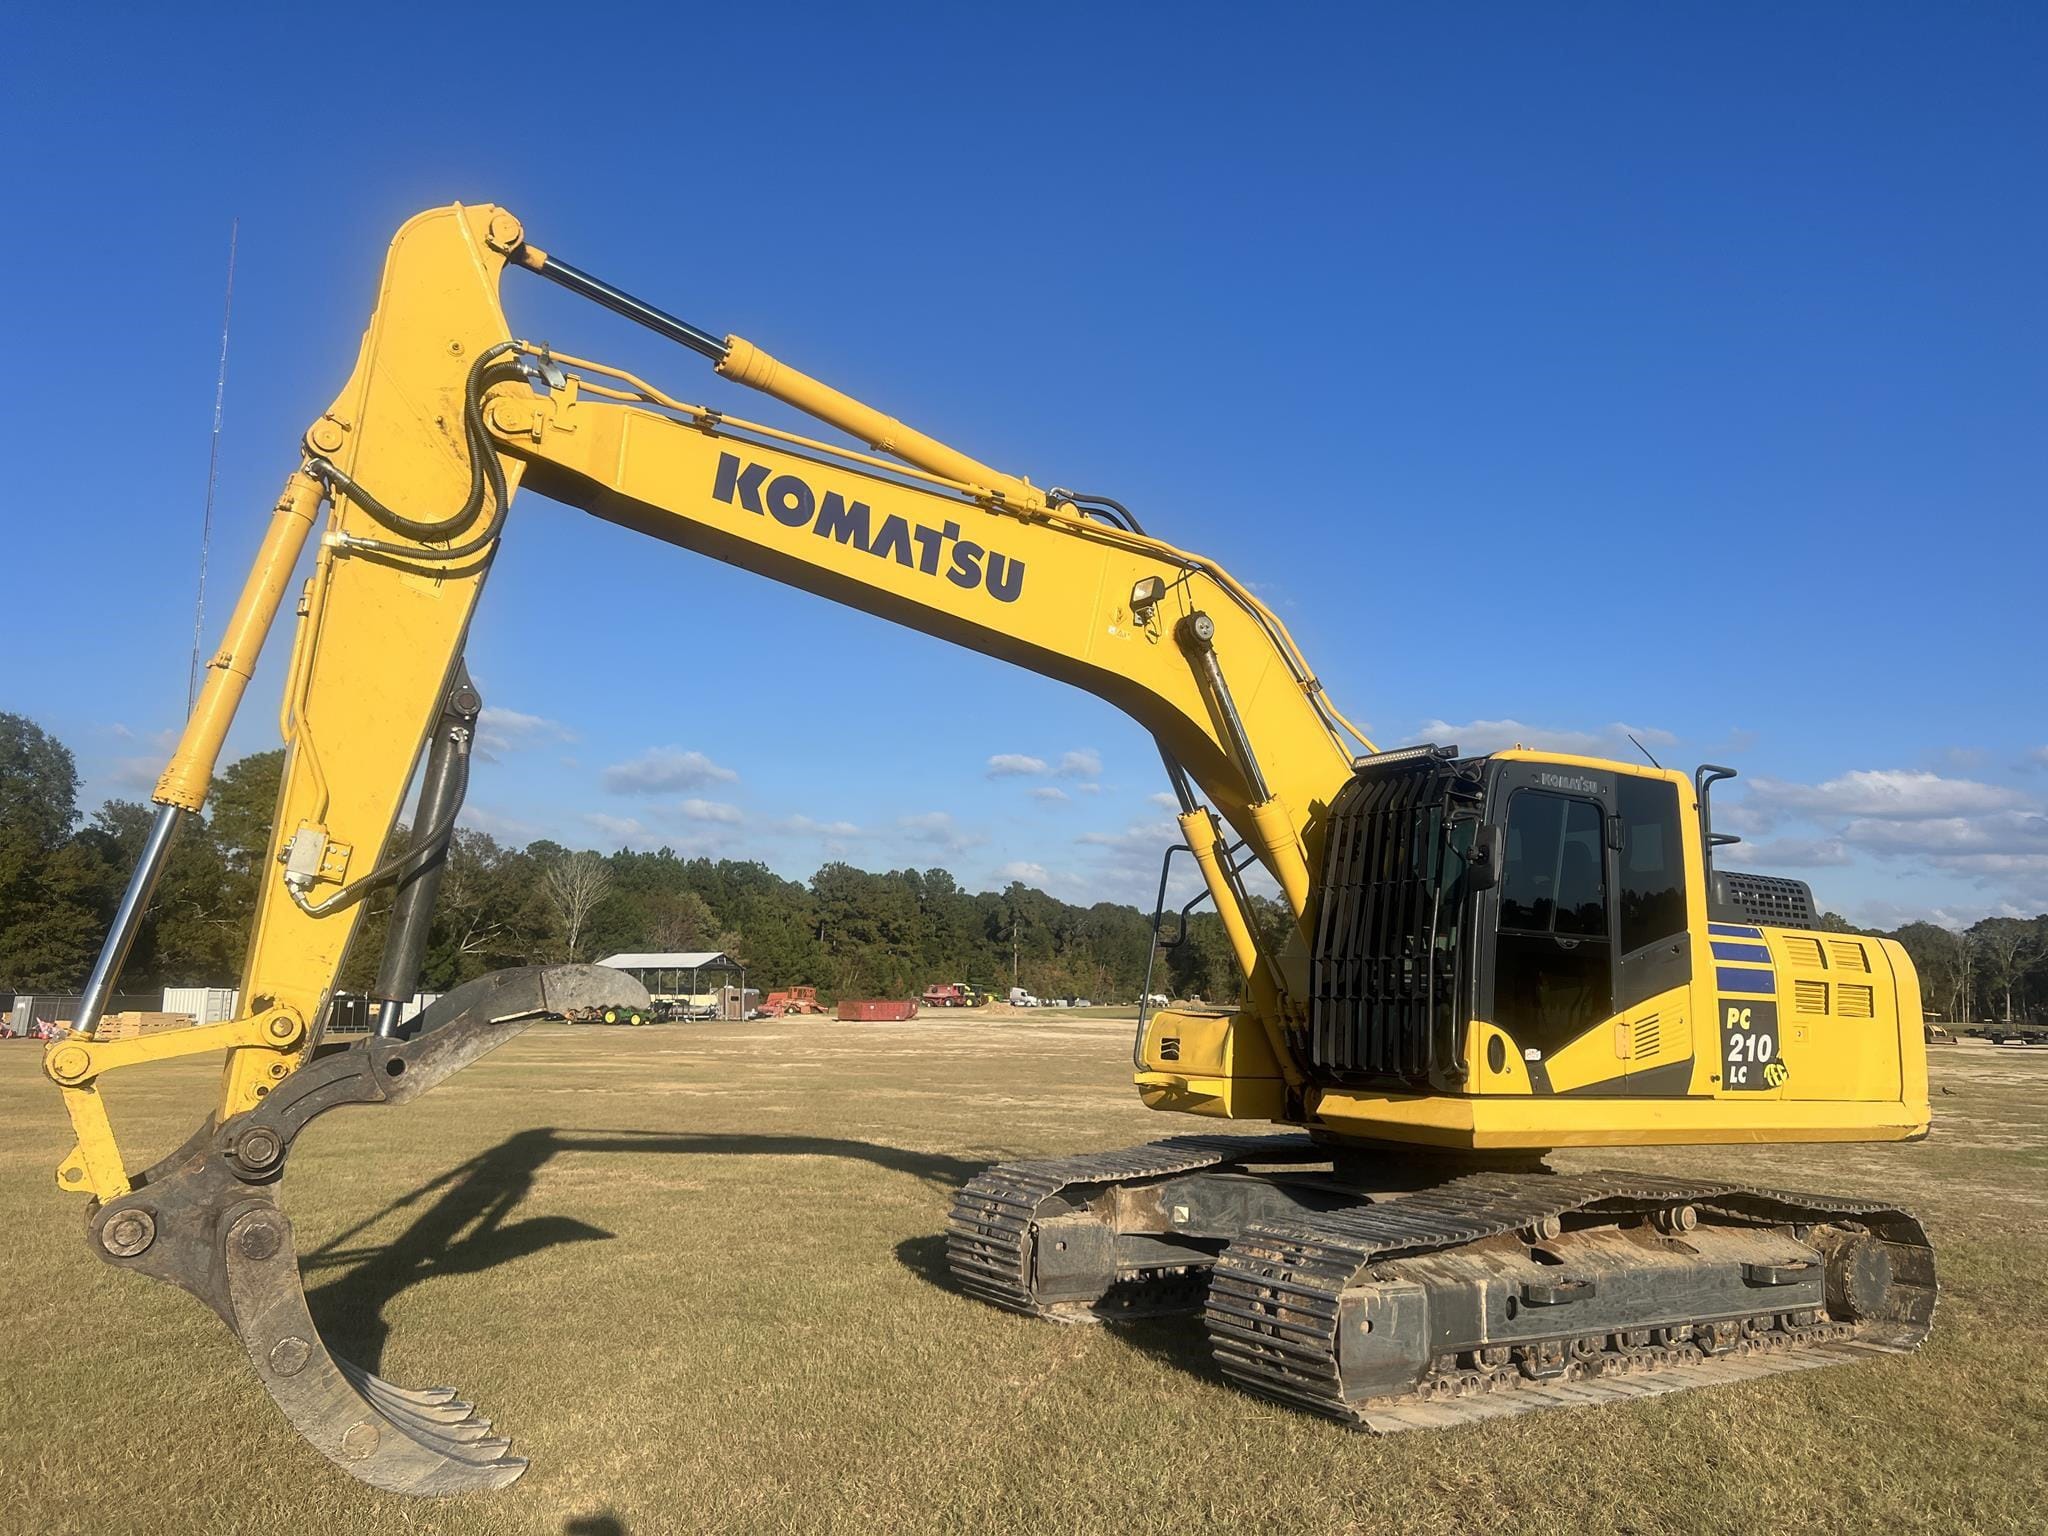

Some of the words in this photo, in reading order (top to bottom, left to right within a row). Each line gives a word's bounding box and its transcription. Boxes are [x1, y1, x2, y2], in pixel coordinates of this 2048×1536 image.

[711, 451, 1026, 603] KOMATSU
[1541, 772, 1598, 793] KOMATSU
[1726, 1007, 1751, 1030] PC
[1727, 1033, 1772, 1063] 210
[1729, 1066, 1747, 1084] LC
